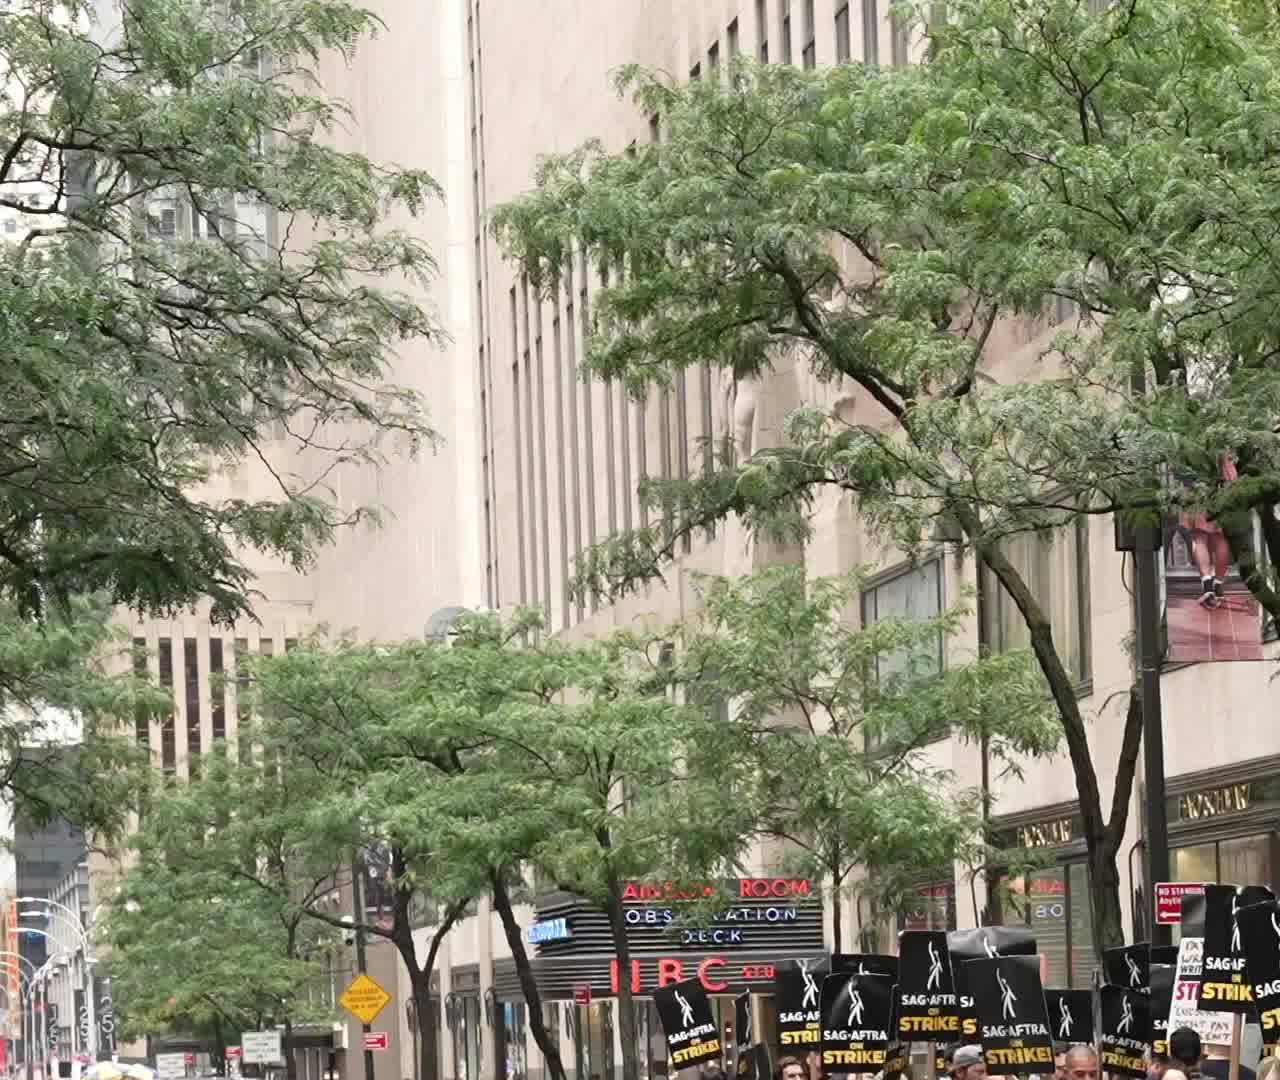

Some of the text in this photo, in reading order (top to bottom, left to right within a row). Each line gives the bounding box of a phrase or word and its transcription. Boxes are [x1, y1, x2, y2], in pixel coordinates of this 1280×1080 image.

[740, 878, 810, 898] ROOM
[1201, 982, 1255, 1002] STRIK
[900, 1016, 960, 1033] STRIKE
[672, 1039, 721, 1063] STRIKE!
[823, 1050, 888, 1065] STRIKE!
[985, 1046, 1053, 1066] STRIKE!
